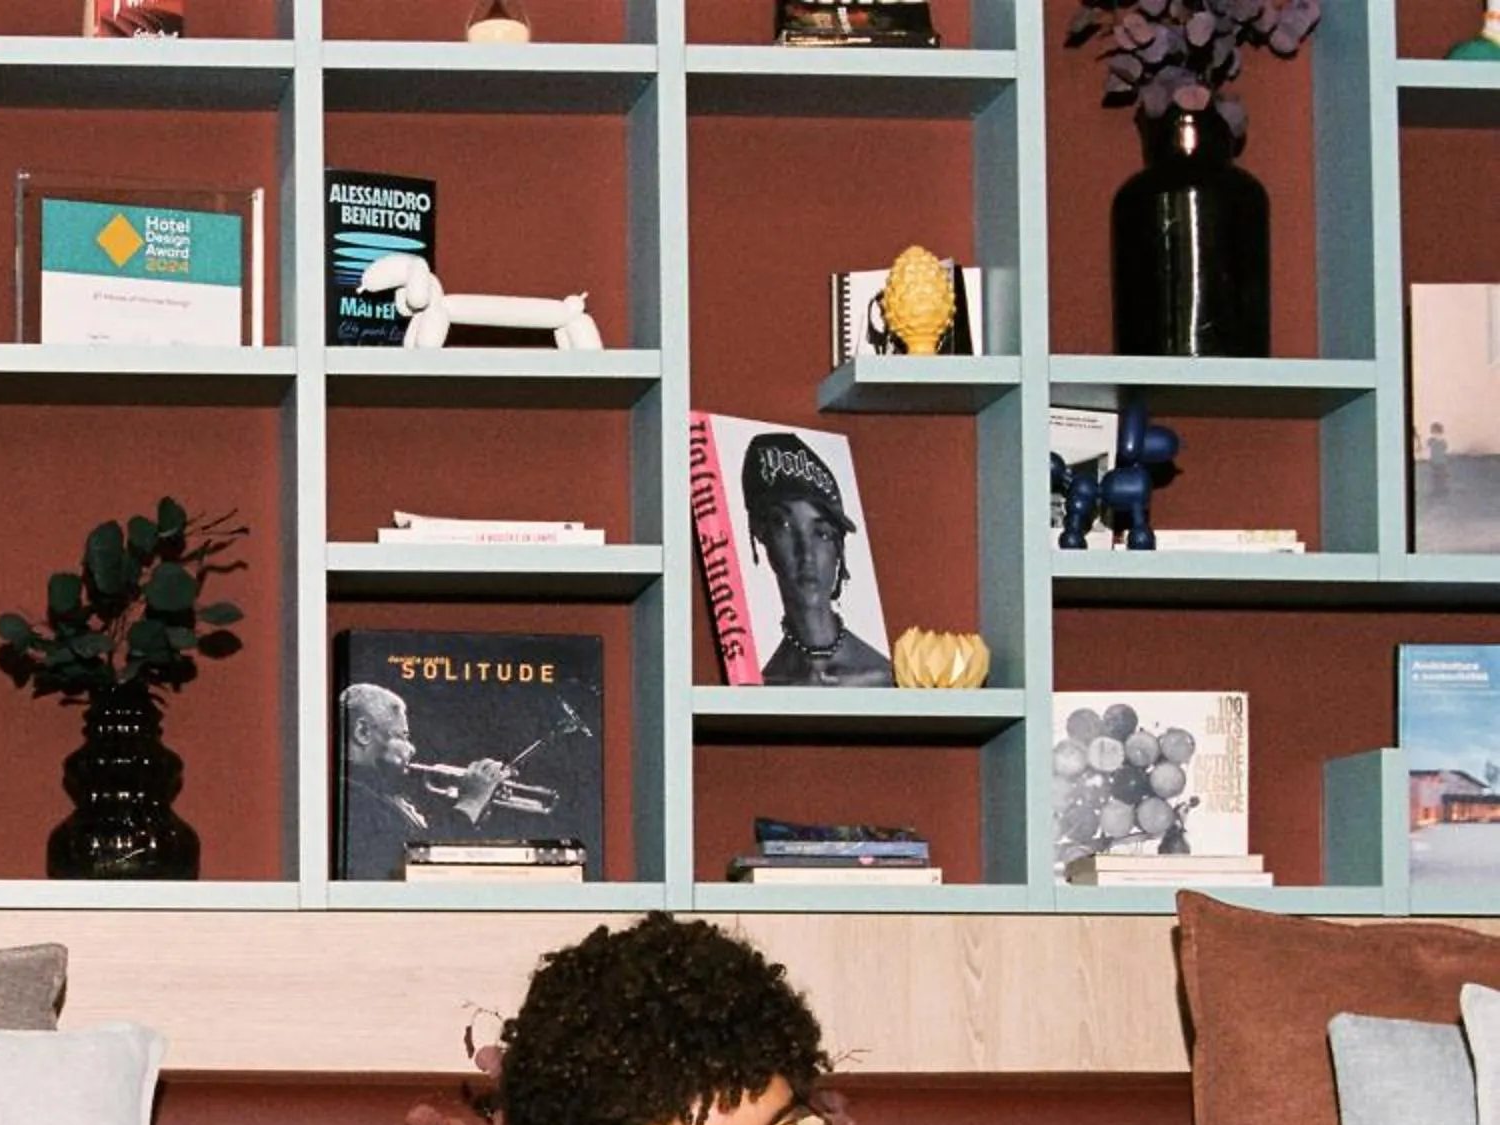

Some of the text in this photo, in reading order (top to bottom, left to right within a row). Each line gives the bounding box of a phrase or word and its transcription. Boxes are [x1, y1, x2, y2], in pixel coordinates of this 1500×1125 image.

[330, 183, 431, 212] ALESSANDRO
[145, 215, 191, 233] Hotel
[341, 205, 421, 231] BENETTON
[145, 231, 191, 247] Design
[145, 244, 189, 259] Award
[146, 258, 189, 274] 2024
[700, 529, 747, 661] Angels
[402, 660, 555, 683] SOLITUDE
[1218, 695, 1243, 717] 100
